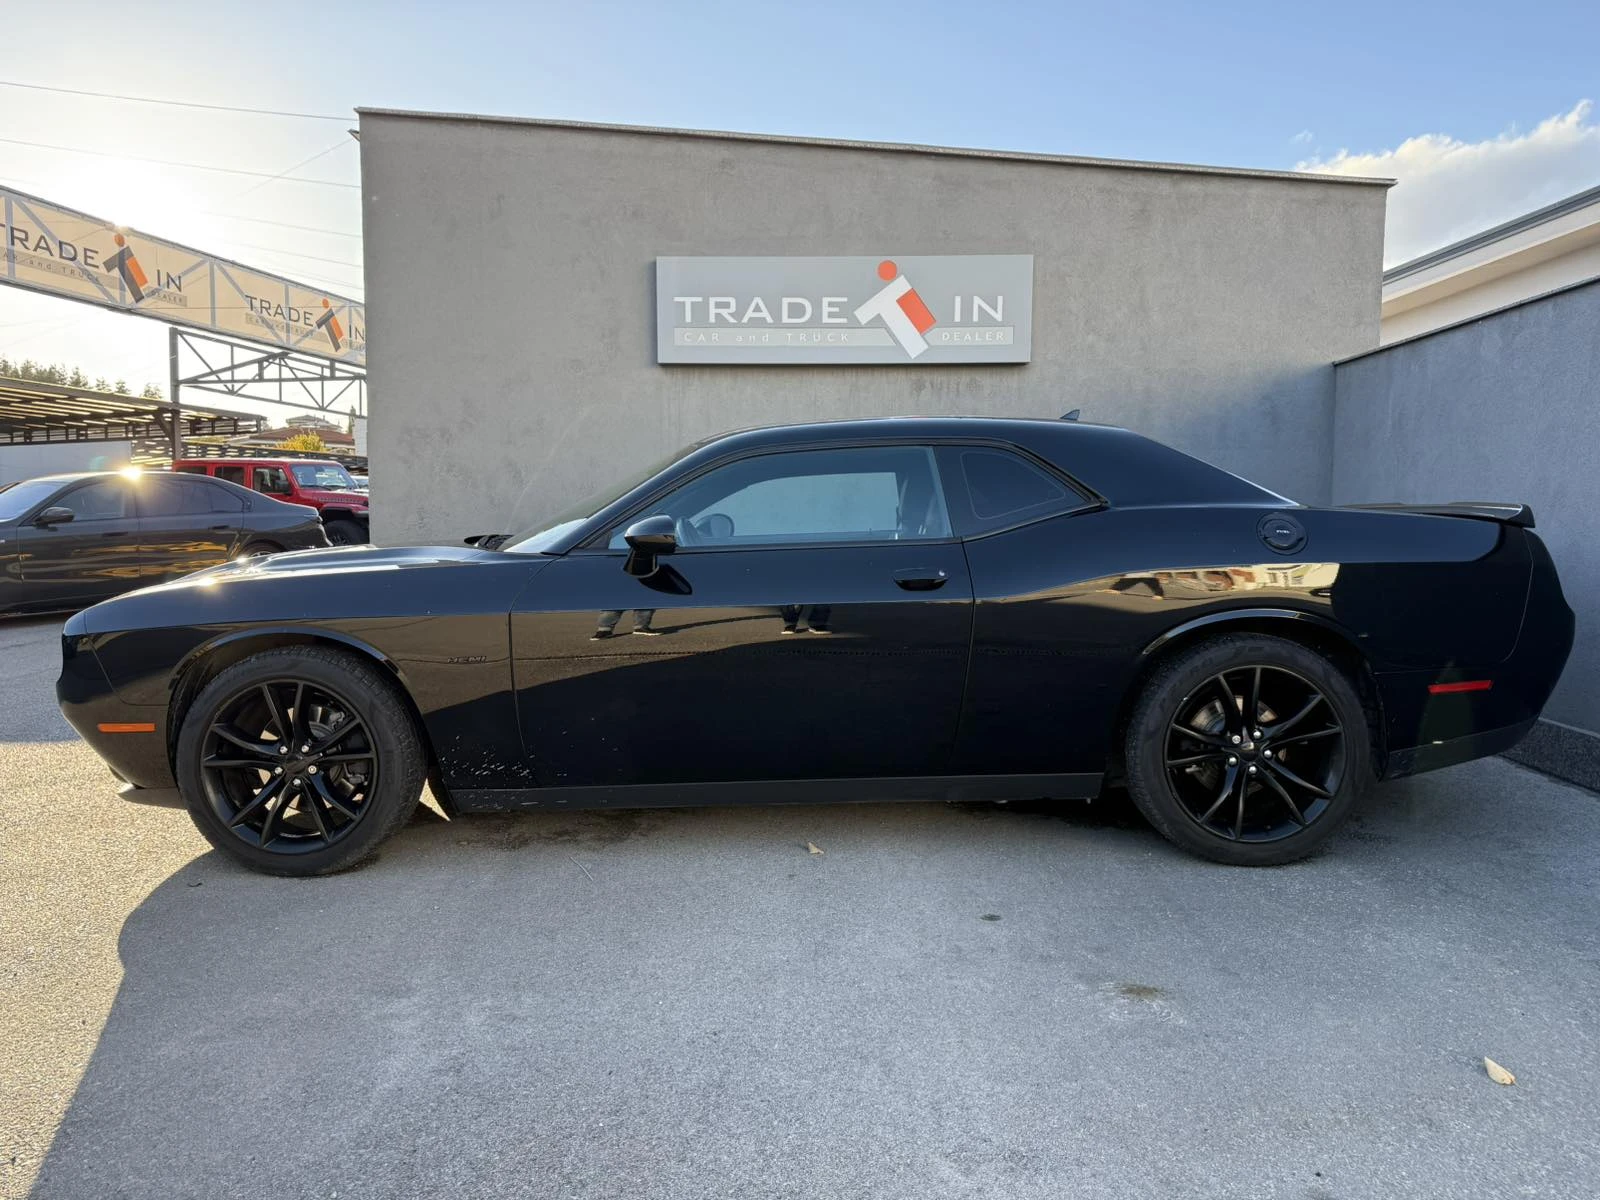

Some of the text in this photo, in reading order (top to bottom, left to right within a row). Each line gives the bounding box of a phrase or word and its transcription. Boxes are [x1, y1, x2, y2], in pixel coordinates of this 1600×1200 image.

[156, 269, 182, 292] IN
[245, 295, 313, 327] TRADE
[673, 296, 848, 323] TRADE
[953, 295, 1003, 322] IN
[684, 331, 1005, 342] CAR and TRUCK DEALER
